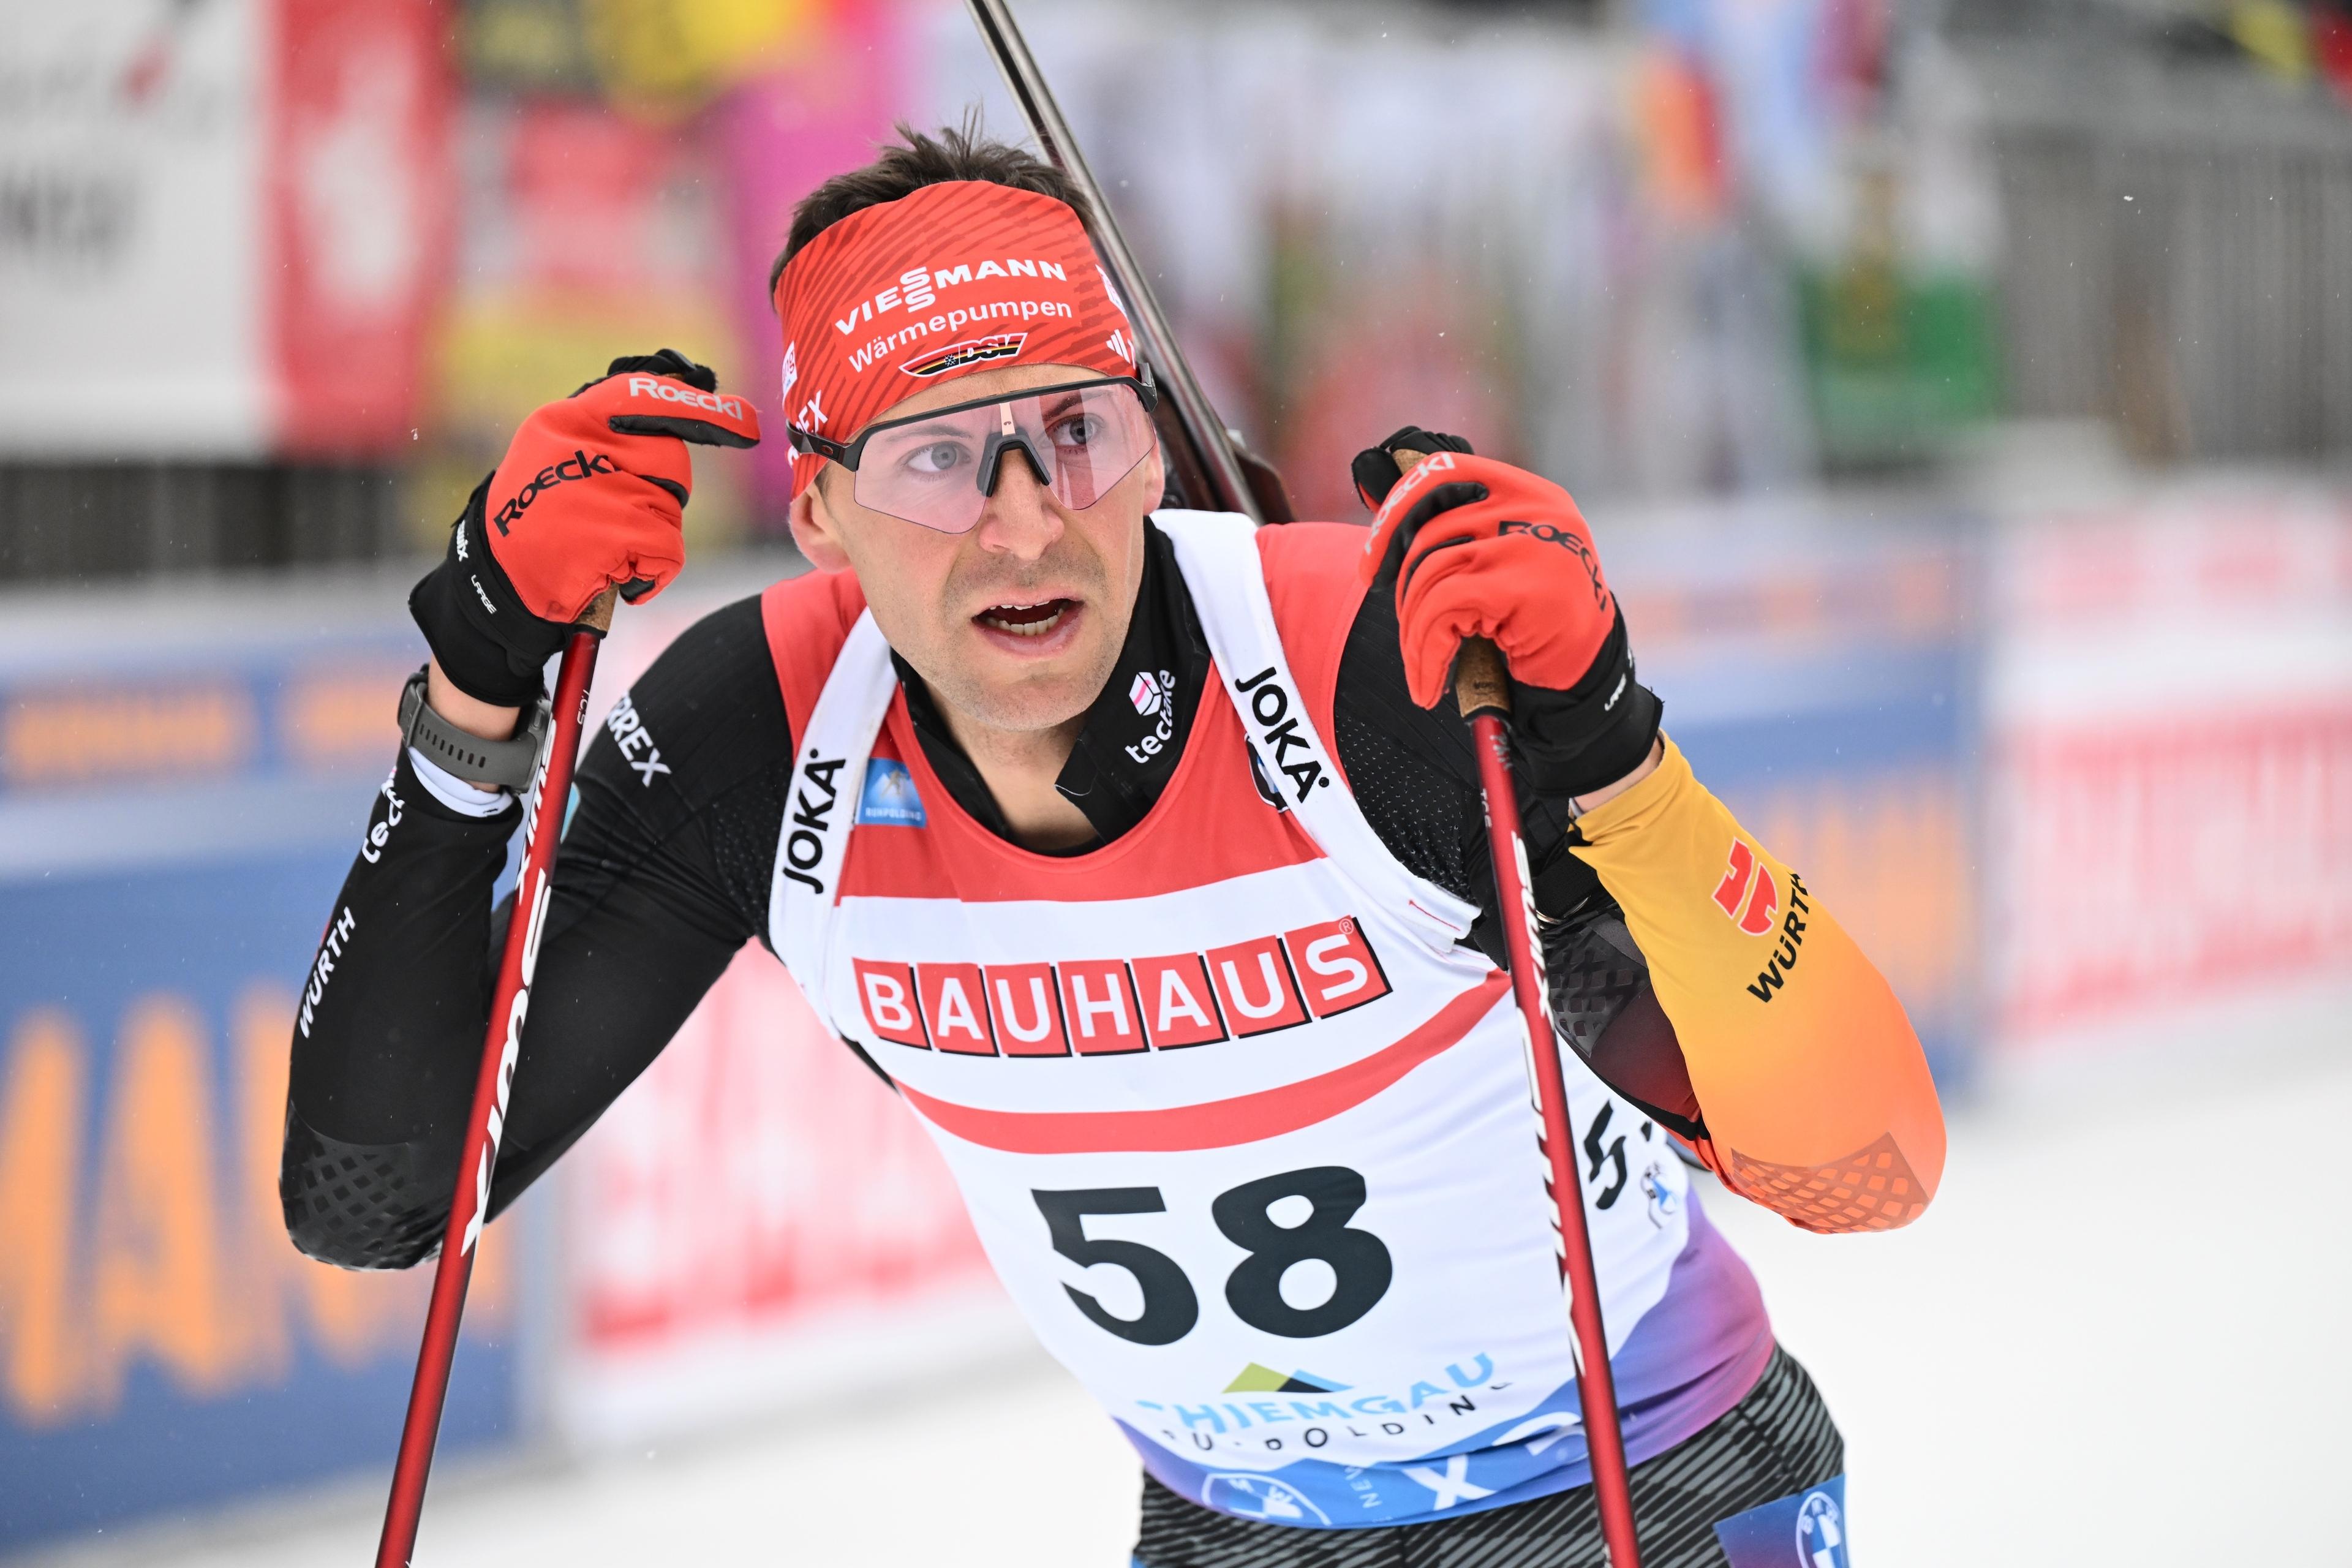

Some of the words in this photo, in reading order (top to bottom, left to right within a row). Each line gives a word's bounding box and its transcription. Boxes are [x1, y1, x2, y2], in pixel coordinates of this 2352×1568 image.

[835, 258, 1067, 336] VIESSMANN
[848, 298, 1072, 373] Wärmepumpen
[960, 333, 1028, 363] DSV
[1235, 666, 1322, 804] JOKA
[782, 755, 846, 895] JOKA
[862, 932, 1369, 1043] BAUHAUS
[1746, 872, 1809, 1003] WÜRTH
[1030, 1165, 1393, 1346] 58
[1134, 1352, 1494, 1434] HIEMGAU
